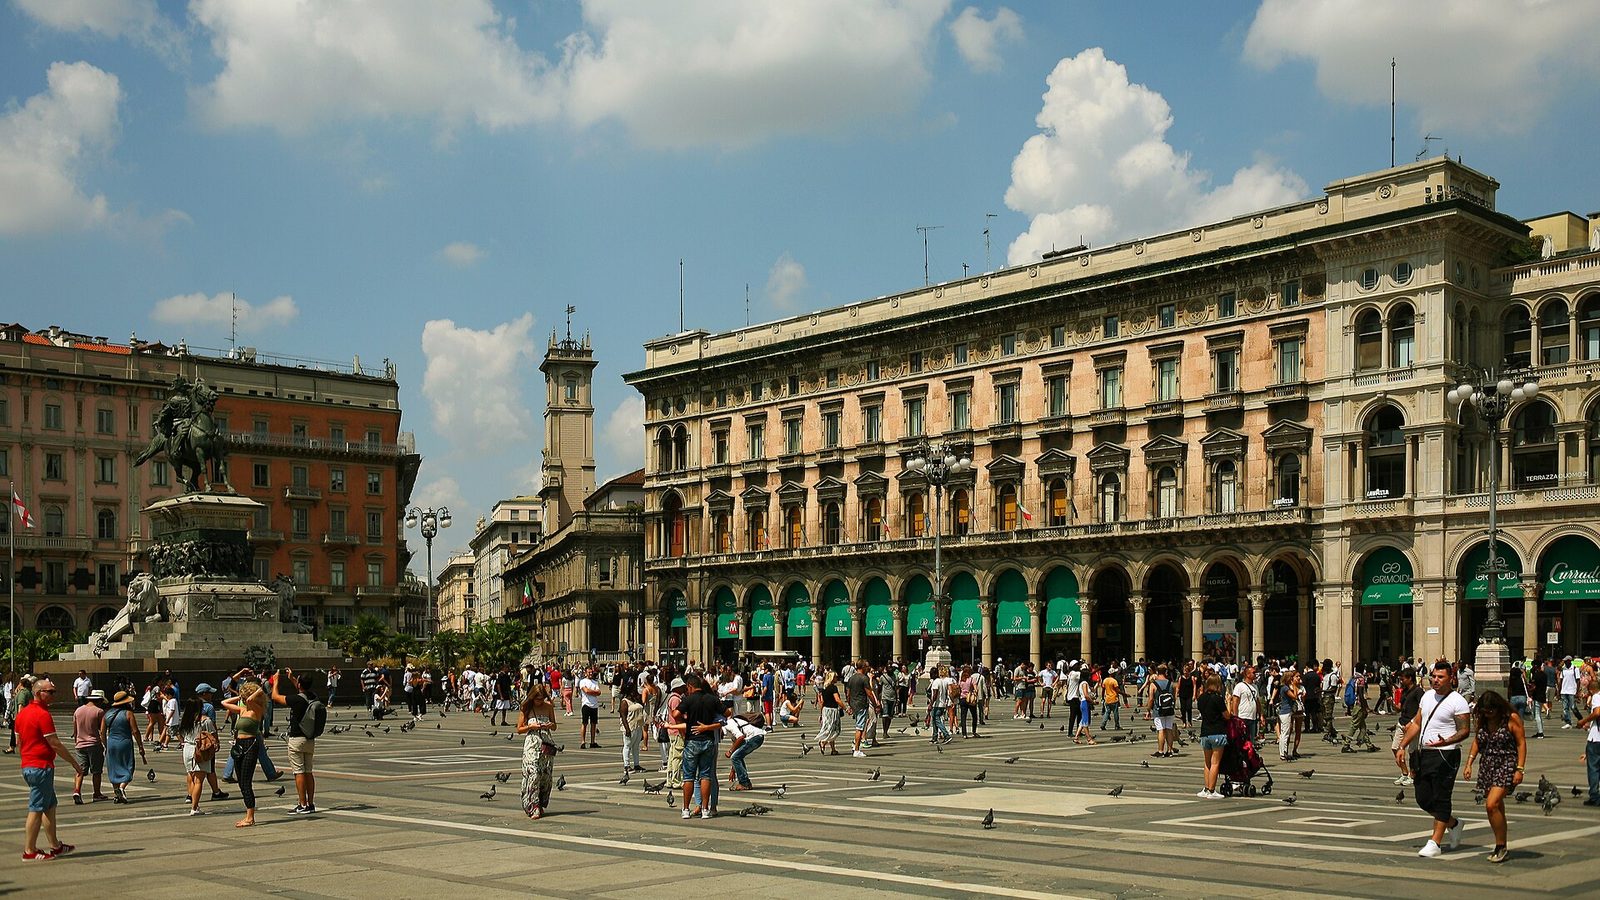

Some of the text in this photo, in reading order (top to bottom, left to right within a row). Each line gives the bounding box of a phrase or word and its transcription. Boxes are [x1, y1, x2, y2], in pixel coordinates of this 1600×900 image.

[1526, 474, 1558, 482] TERRAZZA
[1372, 574, 1410, 584] GRIMOLDI
[730, 623, 737, 631] M
